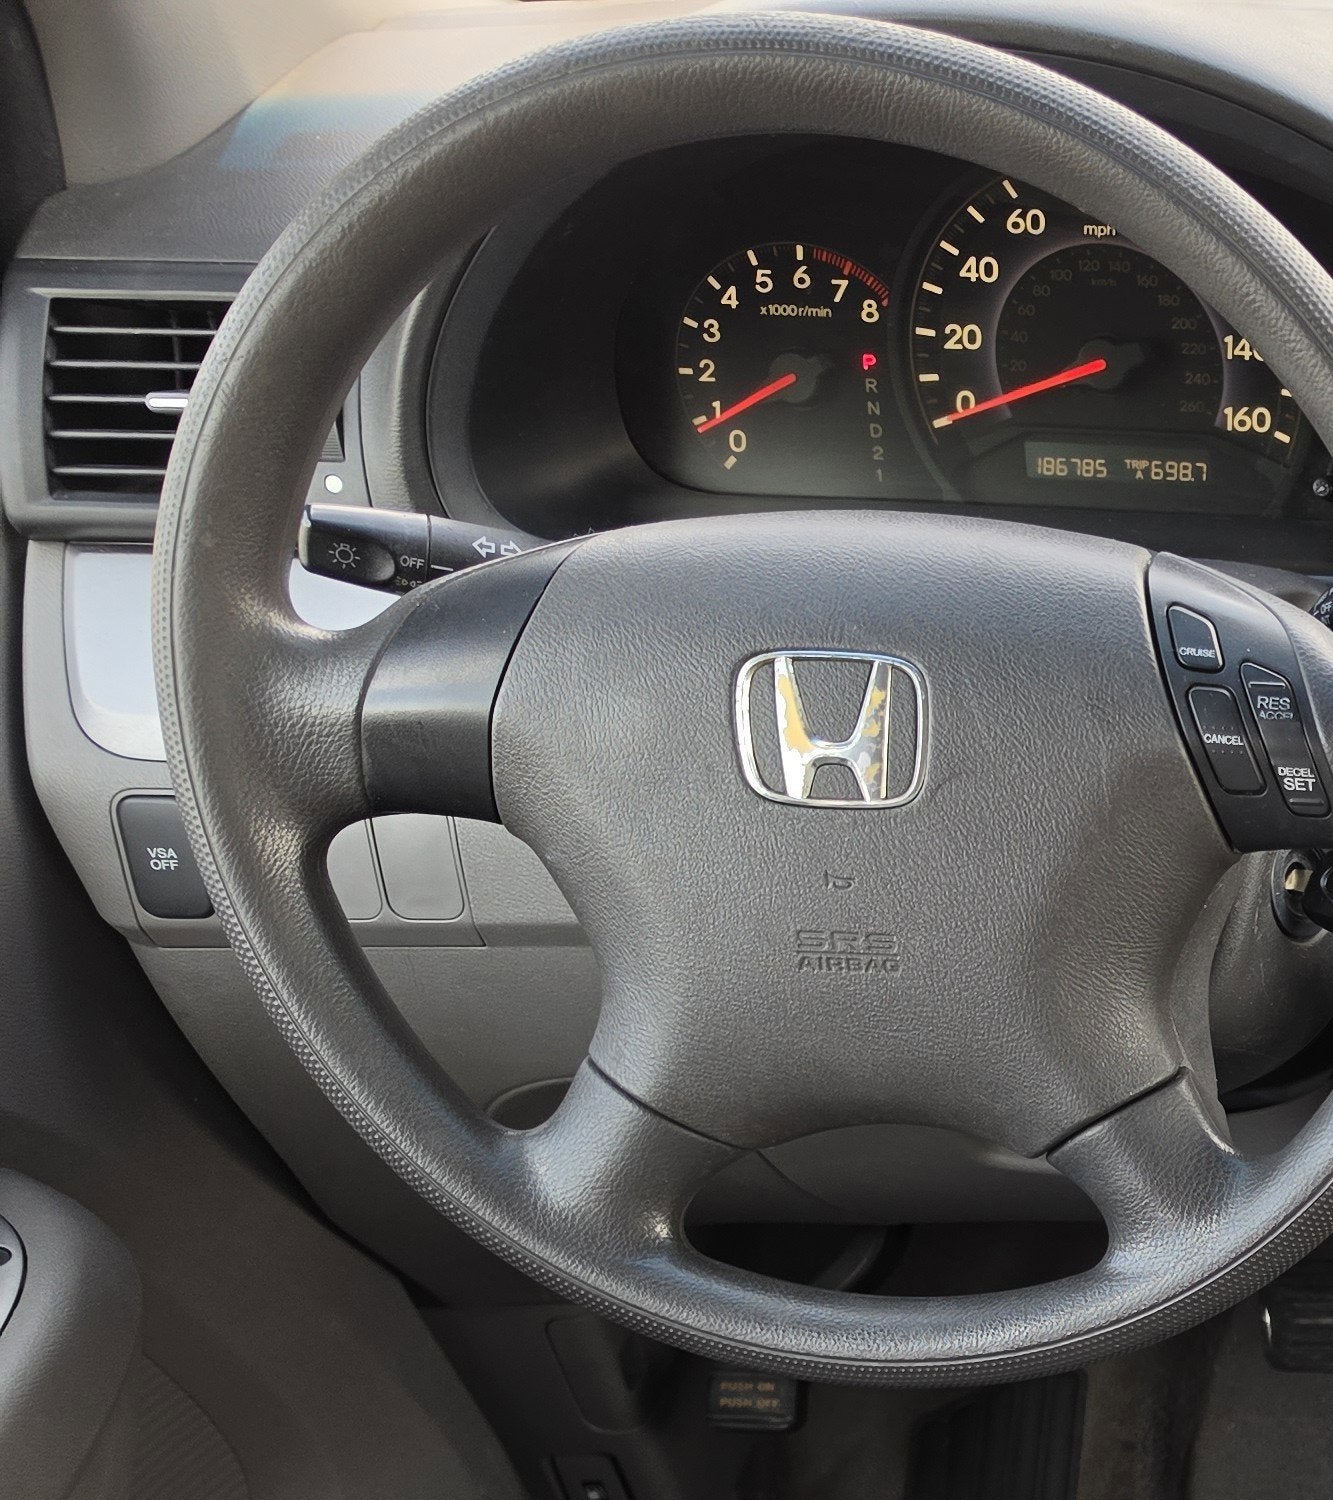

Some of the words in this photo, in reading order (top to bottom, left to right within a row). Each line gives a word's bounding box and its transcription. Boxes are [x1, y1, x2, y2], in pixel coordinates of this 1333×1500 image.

[1006, 208, 1046, 235] 60
[1083, 224, 1116, 240] mph
[793, 266, 811, 289] 6
[959, 257, 999, 283] 40
[755, 270, 773, 293] 5
[831, 279, 849, 302] 7
[721, 286, 739, 309] 4
[861, 299, 879, 323] 8
[703, 319, 721, 342] 3
[943, 324, 982, 350] 20
[698, 359, 716, 382] 2
[861, 353, 877, 371] P
[865, 378, 878, 393] R
[712, 401, 721, 418] 1
[868, 401, 880, 416] N
[955, 390, 976, 413] 0
[1223, 406, 1272, 433] 160
[870, 424, 882, 438] D
[729, 430, 746, 452] 0
[872, 447, 885, 461] 2
[876, 468, 882, 482] 1
[1037, 457, 1107, 478] 186785
[1124, 459, 1149, 470] TRIP
[1151, 461, 1207, 482] 698.7
[1135, 470, 1144, 479] A
[400, 555, 424, 569] OFF
[1179, 646, 1216, 658] CRUISE
[1257, 695, 1290, 711] RES
[1204, 732, 1244, 746] CANCEL
[1278, 766, 1314, 777] DECEL
[1283, 777, 1316, 792] SET
[147, 847, 178, 860] VSA
[150, 857, 179, 871] OFF
[797, 930, 898, 952] SRS
[797, 955, 901, 973] AIRBAG
